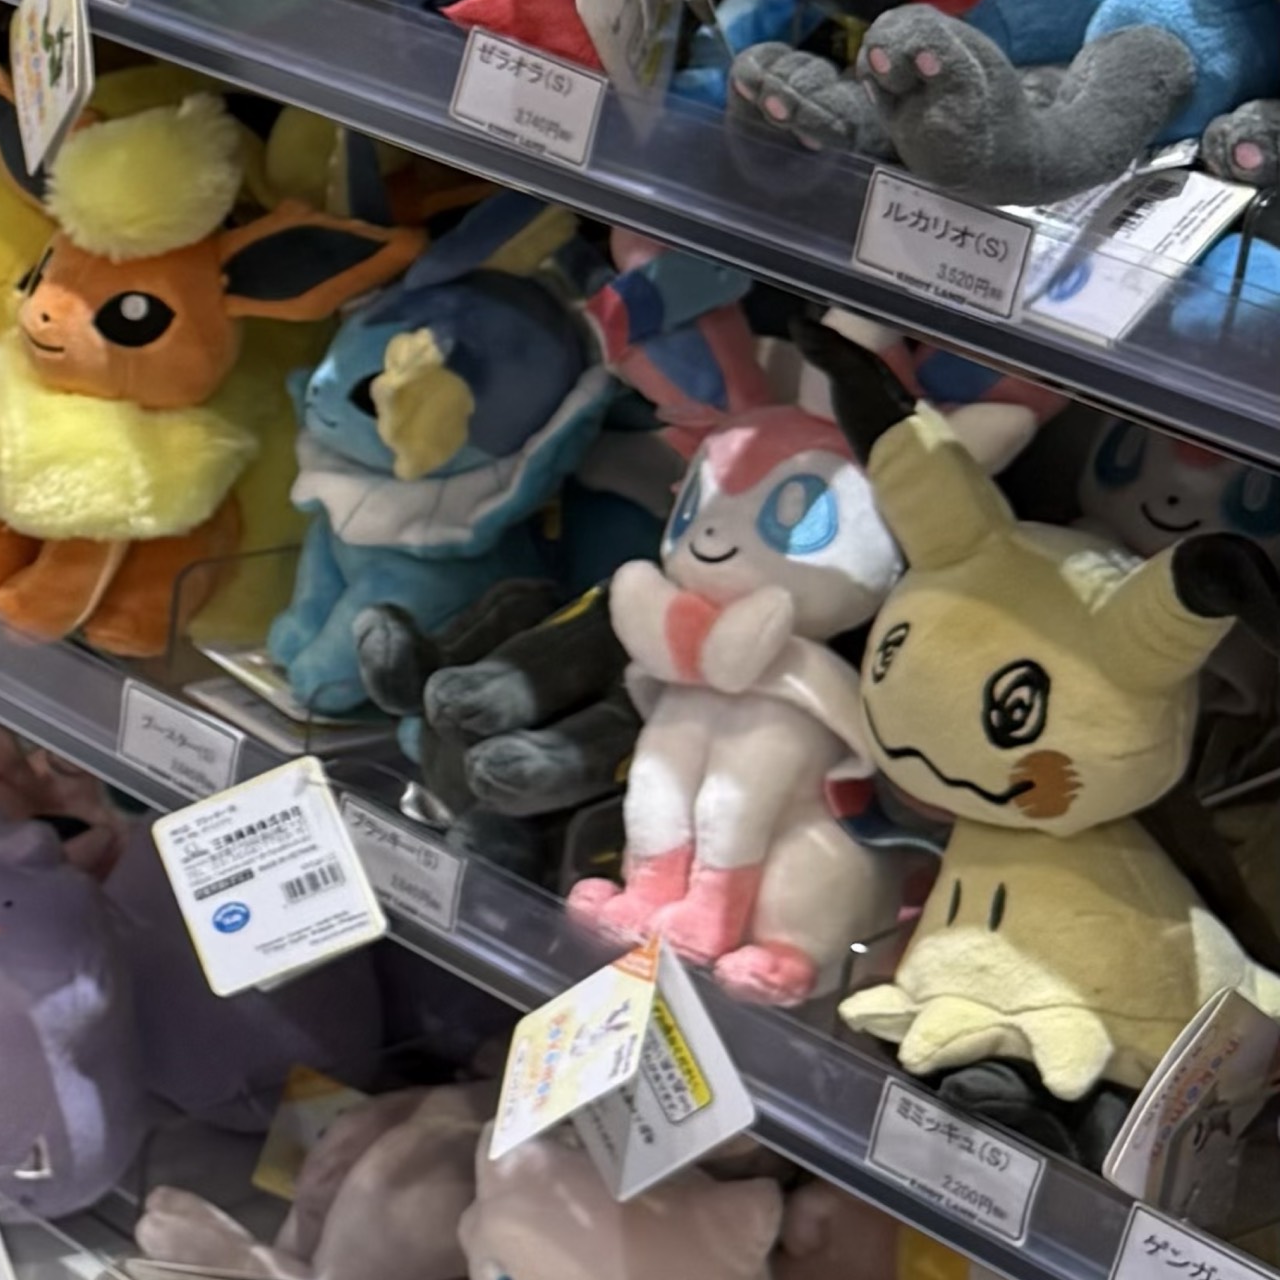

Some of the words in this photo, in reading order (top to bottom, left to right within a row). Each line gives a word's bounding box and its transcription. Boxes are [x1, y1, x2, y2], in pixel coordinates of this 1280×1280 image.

[882, 201, 1009, 263] ルカリオ(S)
[896, 1096, 1010, 1172] ミミッキュ(S)
